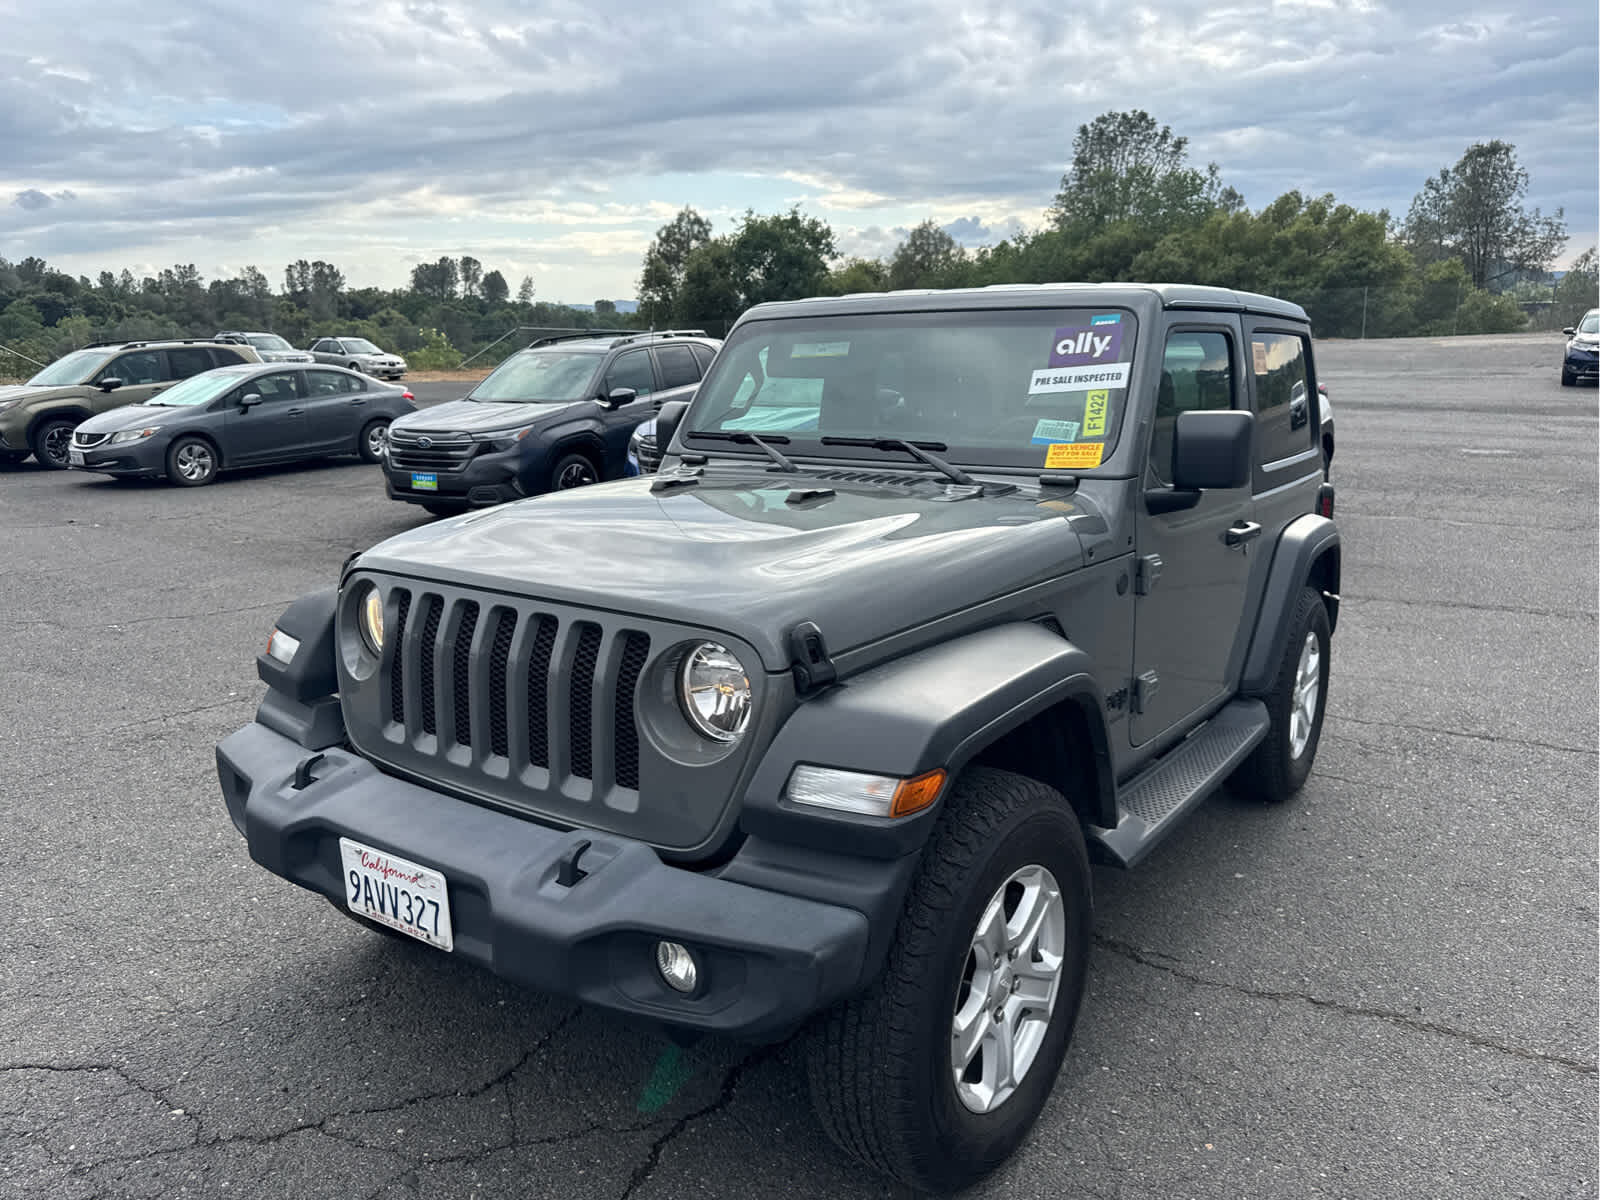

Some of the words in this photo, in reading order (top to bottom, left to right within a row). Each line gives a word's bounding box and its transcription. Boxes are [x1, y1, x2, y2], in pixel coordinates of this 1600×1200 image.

[1034, 376, 1051, 386] PRE
[1052, 374, 1073, 385] SALE
[1074, 371, 1122, 384] INSPECTED
[1087, 393, 1105, 431] F1422
[349, 869, 440, 937] 9AVV327
